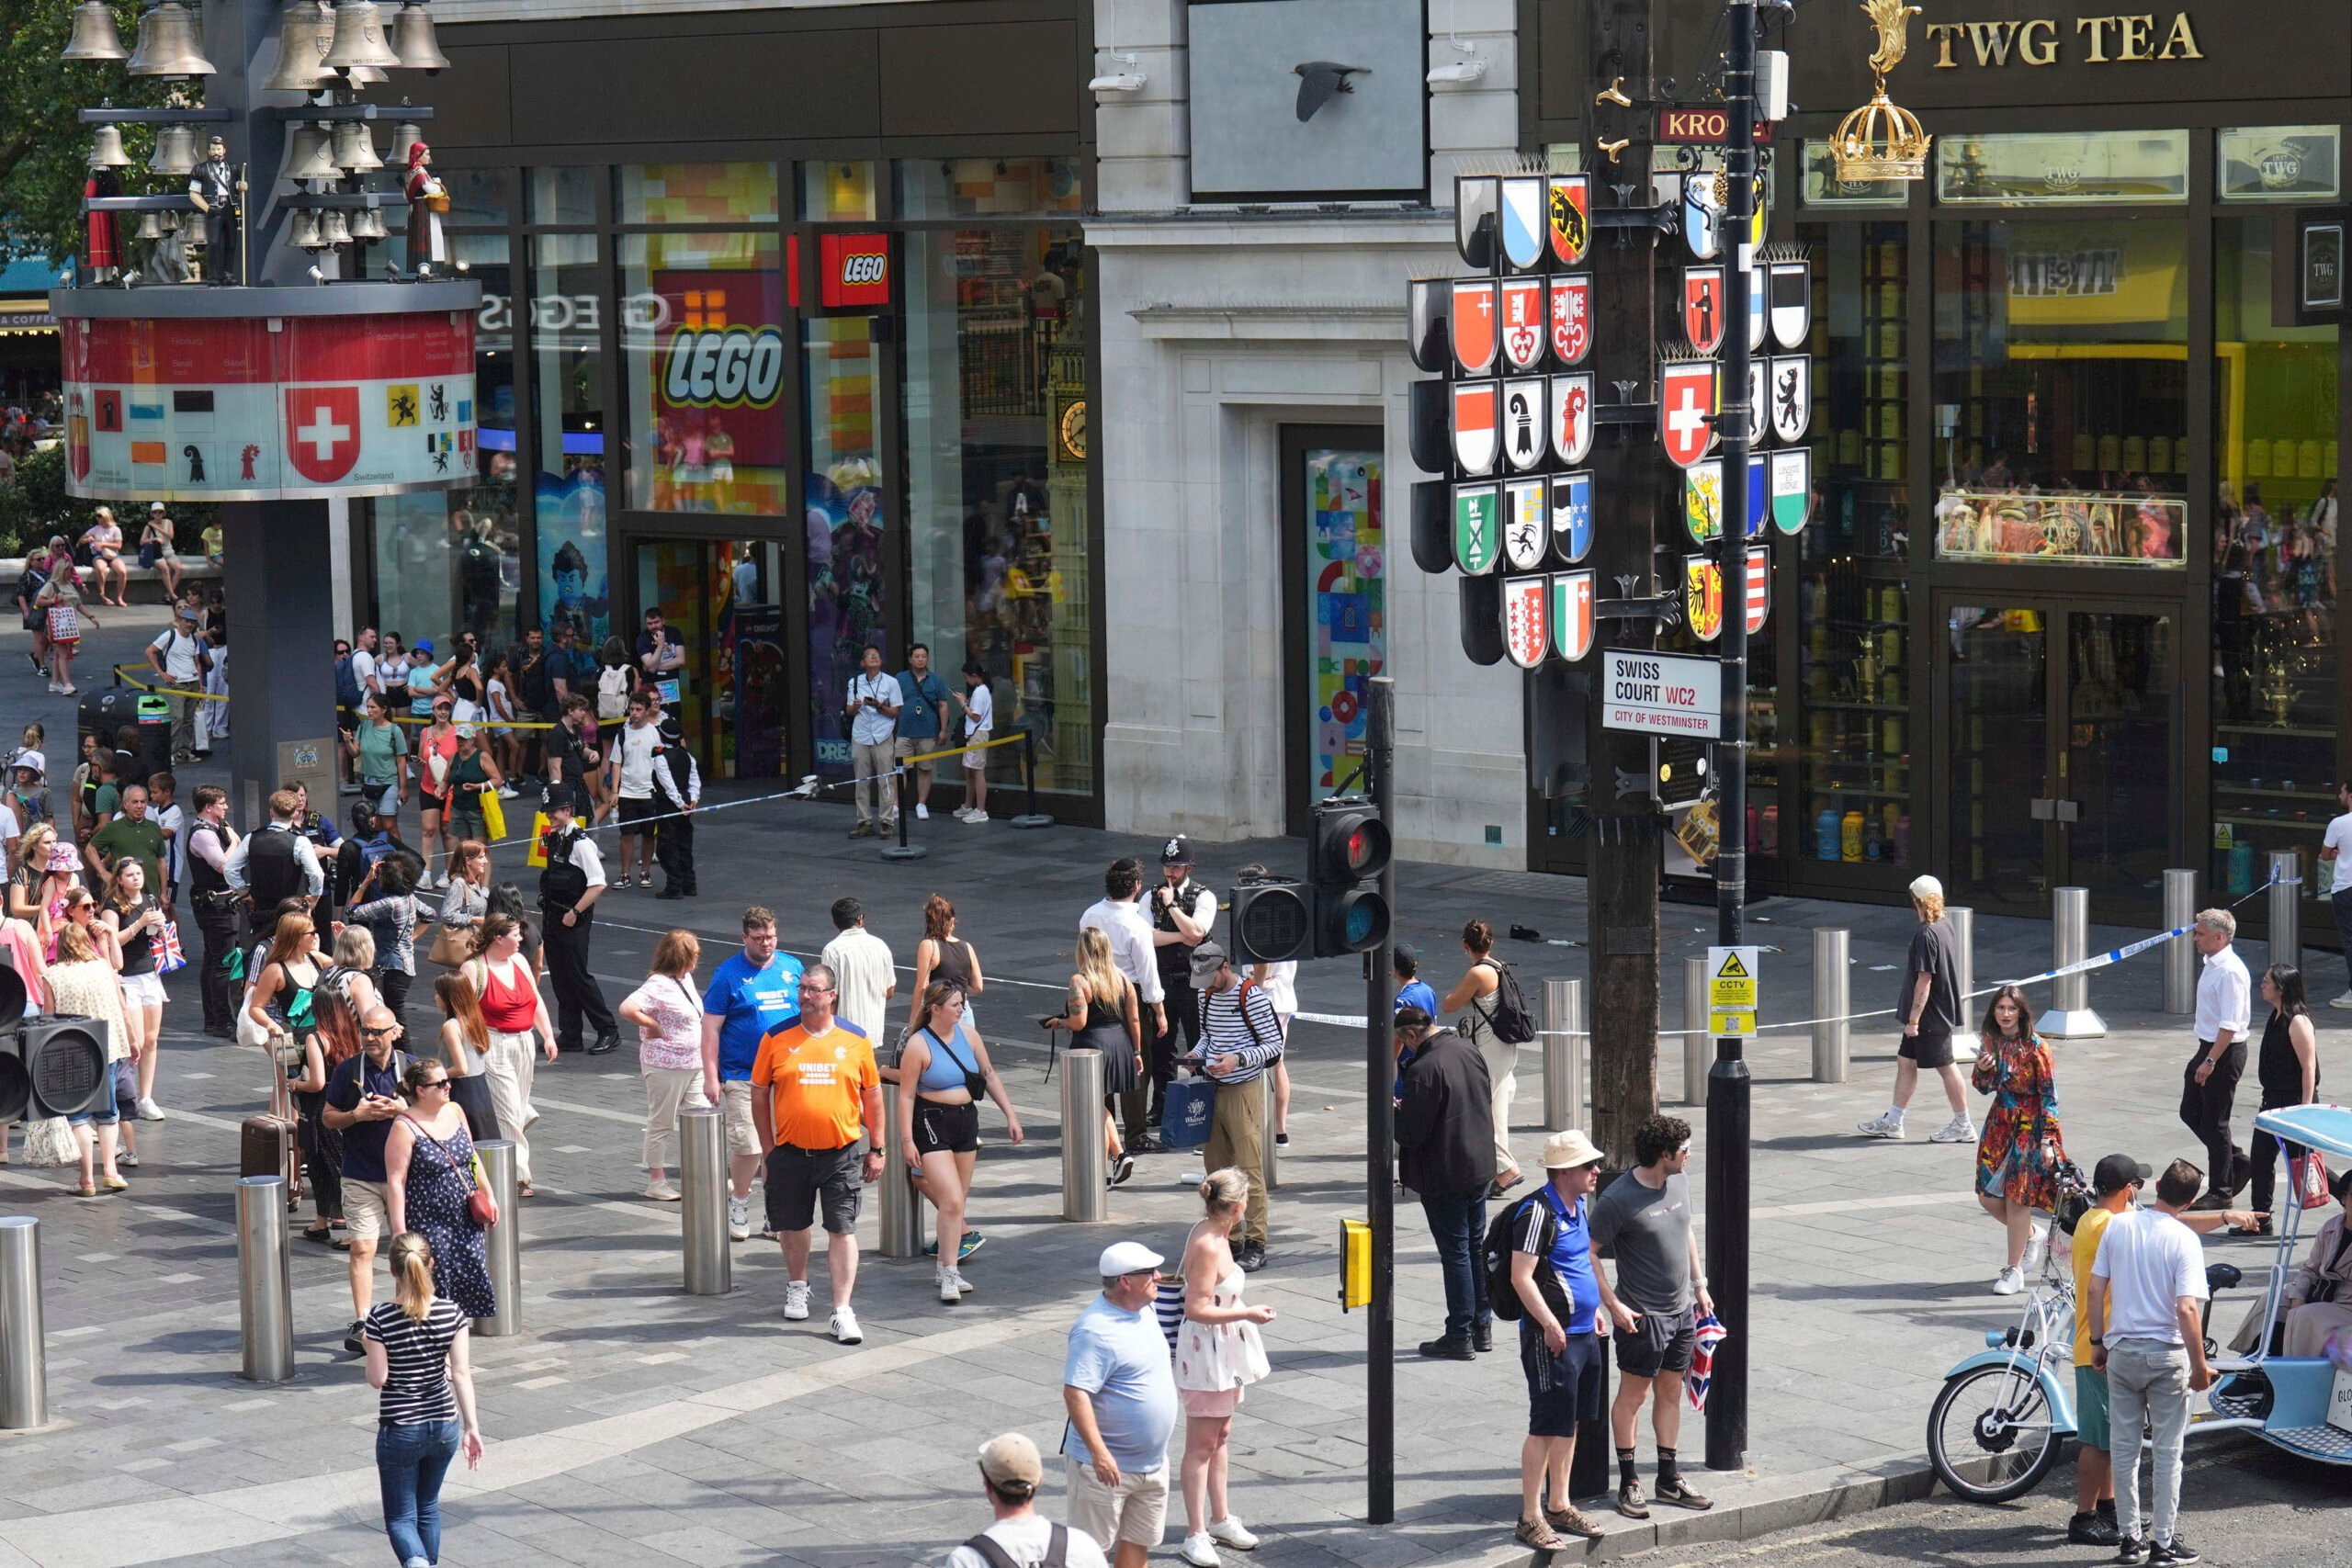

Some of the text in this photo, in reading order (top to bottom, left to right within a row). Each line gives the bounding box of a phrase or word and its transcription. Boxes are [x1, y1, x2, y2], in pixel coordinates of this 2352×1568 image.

[1926, 11, 2204, 68] TWG TEA
[2047, 166, 2076, 179] TWG
[2262, 161, 2298, 175] TWG
[843, 255, 886, 283] LEGO
[2313, 263, 2334, 276] TWG
[12, 315, 58, 324] COFFEE
[171, 337, 203, 346] Fribourg
[172, 359, 193, 367] Basel
[223, 358, 245, 367] Basel
[666, 331, 784, 400] LEGO
[354, 472, 394, 481] Switzerland
[1616, 660, 1660, 680] SWISS
[1615, 682, 1695, 706] COURT WC2
[1615, 710, 1709, 729] CITY OF WESTMINSTER
[1720, 981, 1746, 989] CCTV
[755, 990, 789, 1000] UNIBET
[797, 1063, 838, 1073] UNIBET
[2338, 1388, 2352, 1403] GLO
